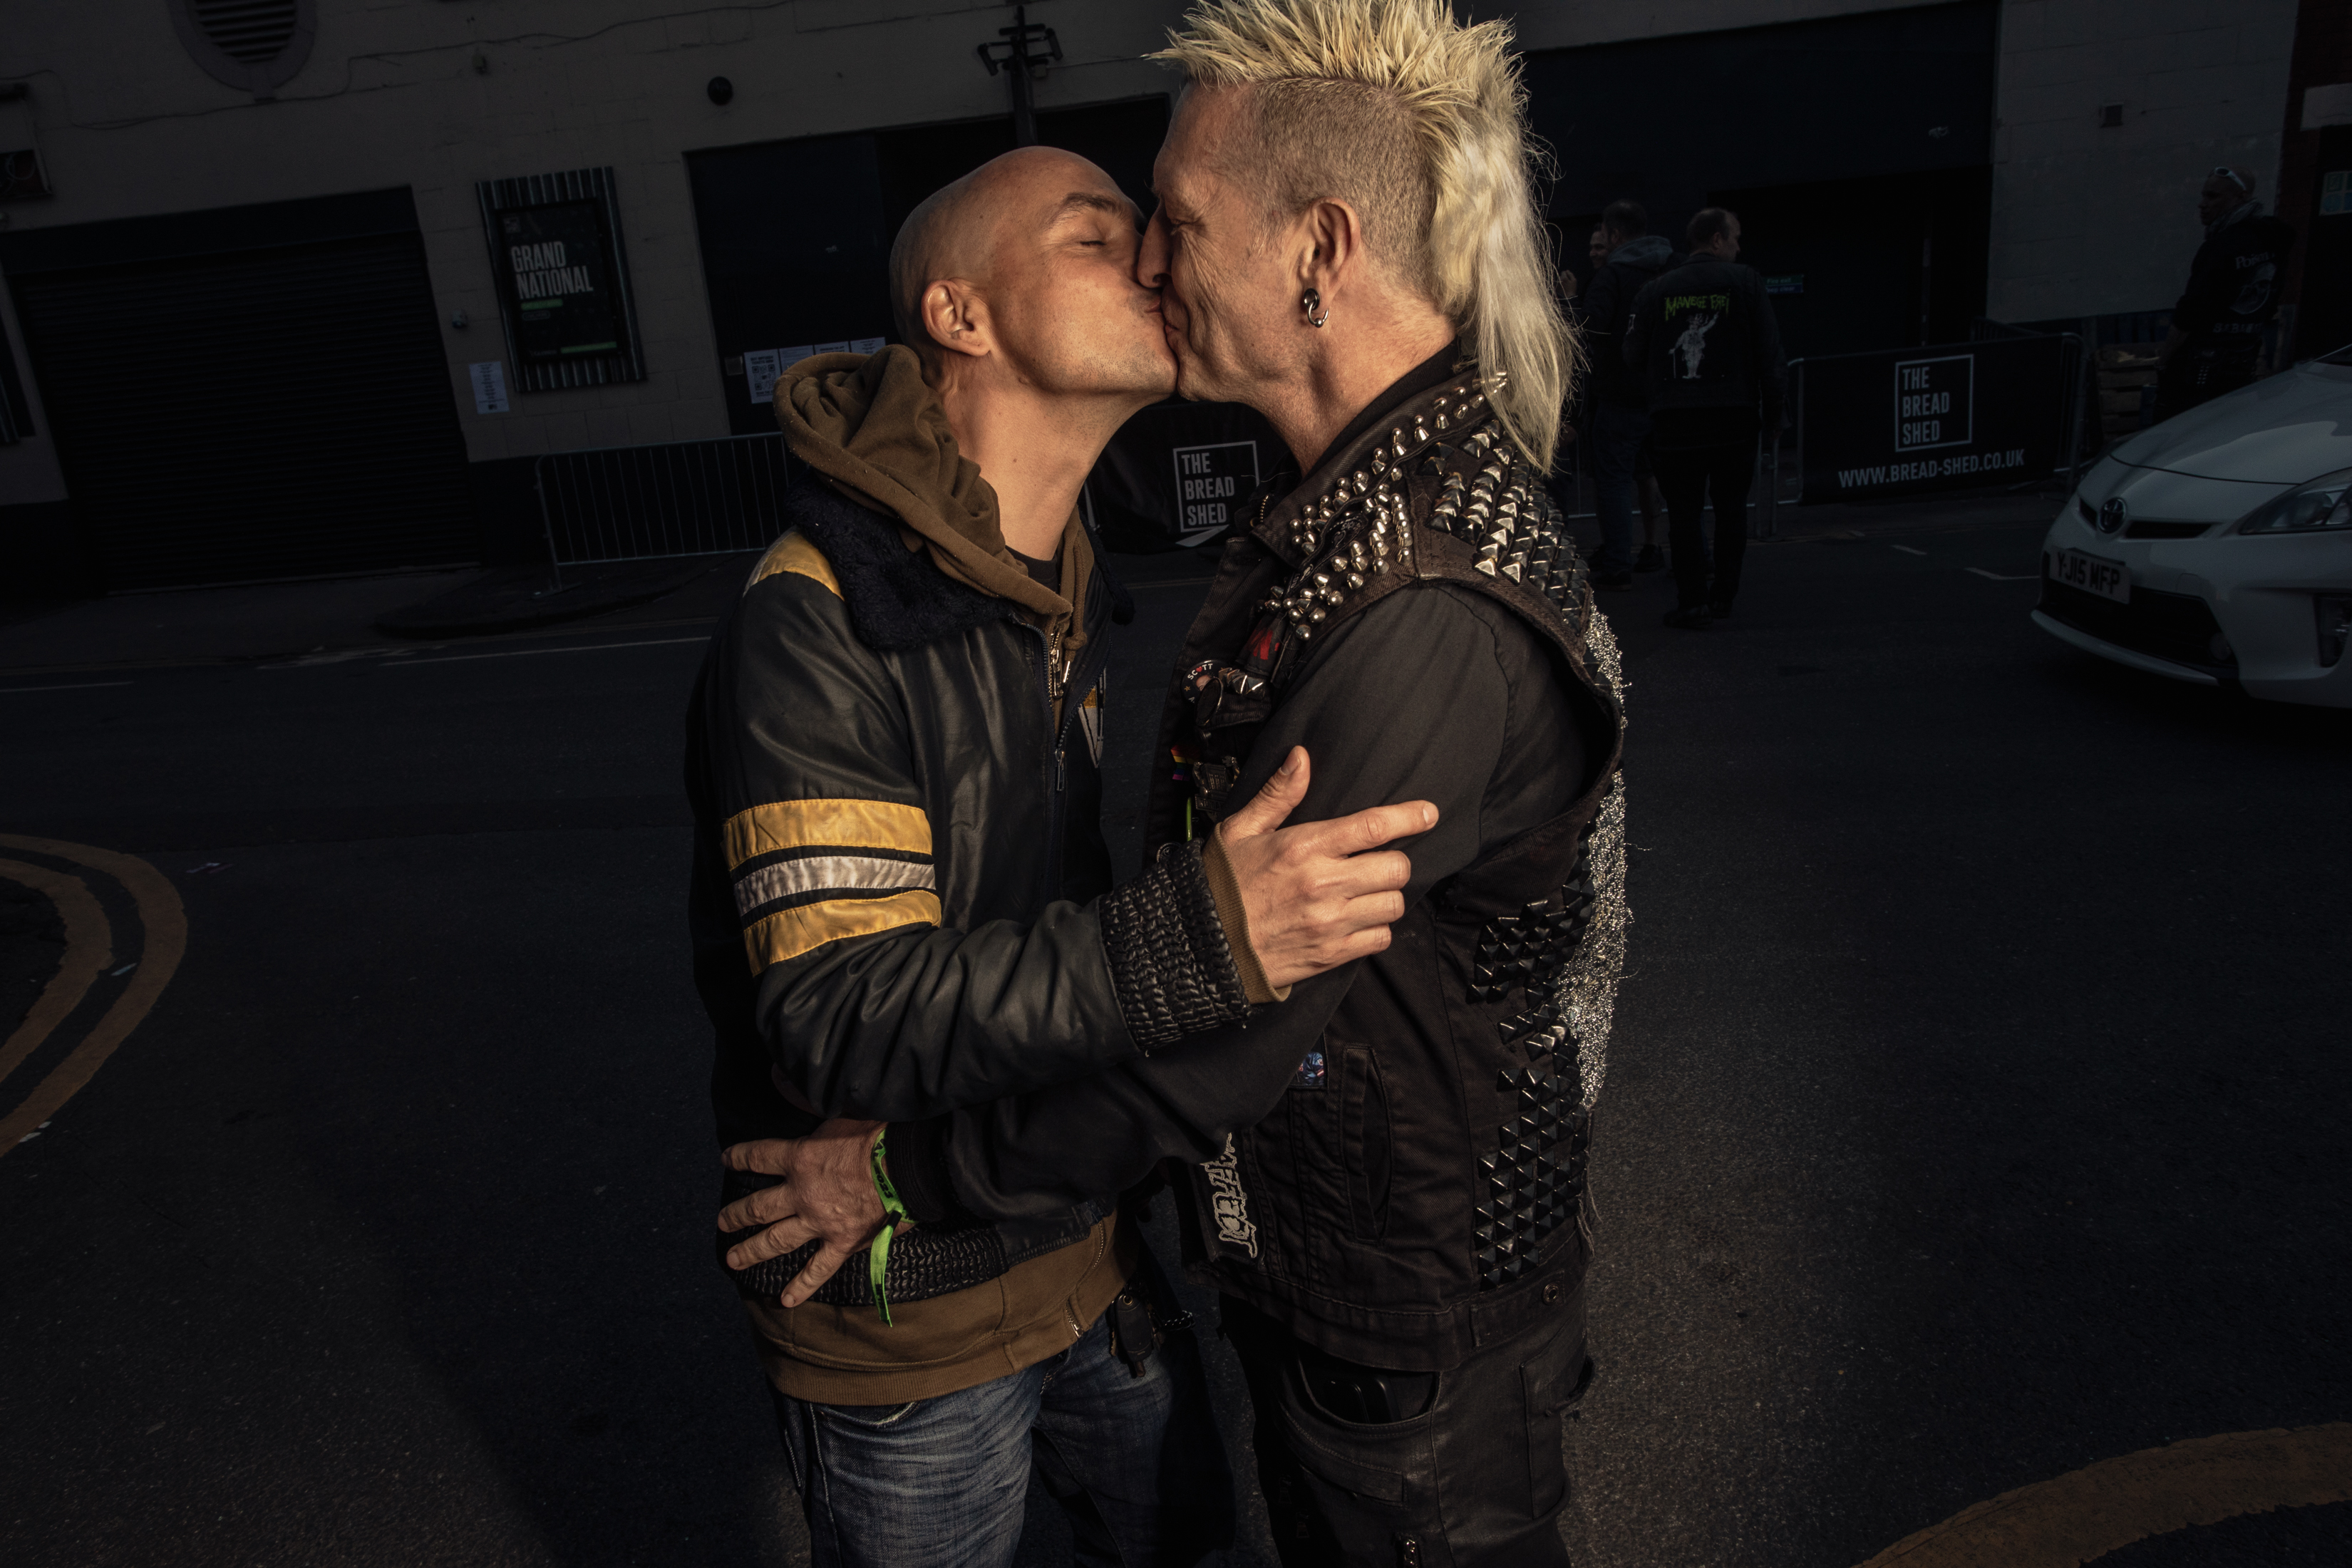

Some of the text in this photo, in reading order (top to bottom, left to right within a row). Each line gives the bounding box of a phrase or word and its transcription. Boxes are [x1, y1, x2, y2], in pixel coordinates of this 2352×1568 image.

[510, 241, 567, 273] GRAND
[515, 265, 594, 300] NATIONAL
[1665, 296, 1708, 321] MANEGE
[1902, 366, 1930, 391] THE
[1902, 391, 1950, 418] BREAD
[1902, 420, 1940, 445] SHED
[1181, 452, 1212, 475] THE
[1838, 448, 2025, 488] WWW.BREAD-SHED.CO.UK
[1184, 476, 1235, 500] BREAD
[1187, 502, 1227, 526] SHED
[2058, 552, 2120, 594] YJ15 MFP
[873, 1165, 894, 1199] 2023
